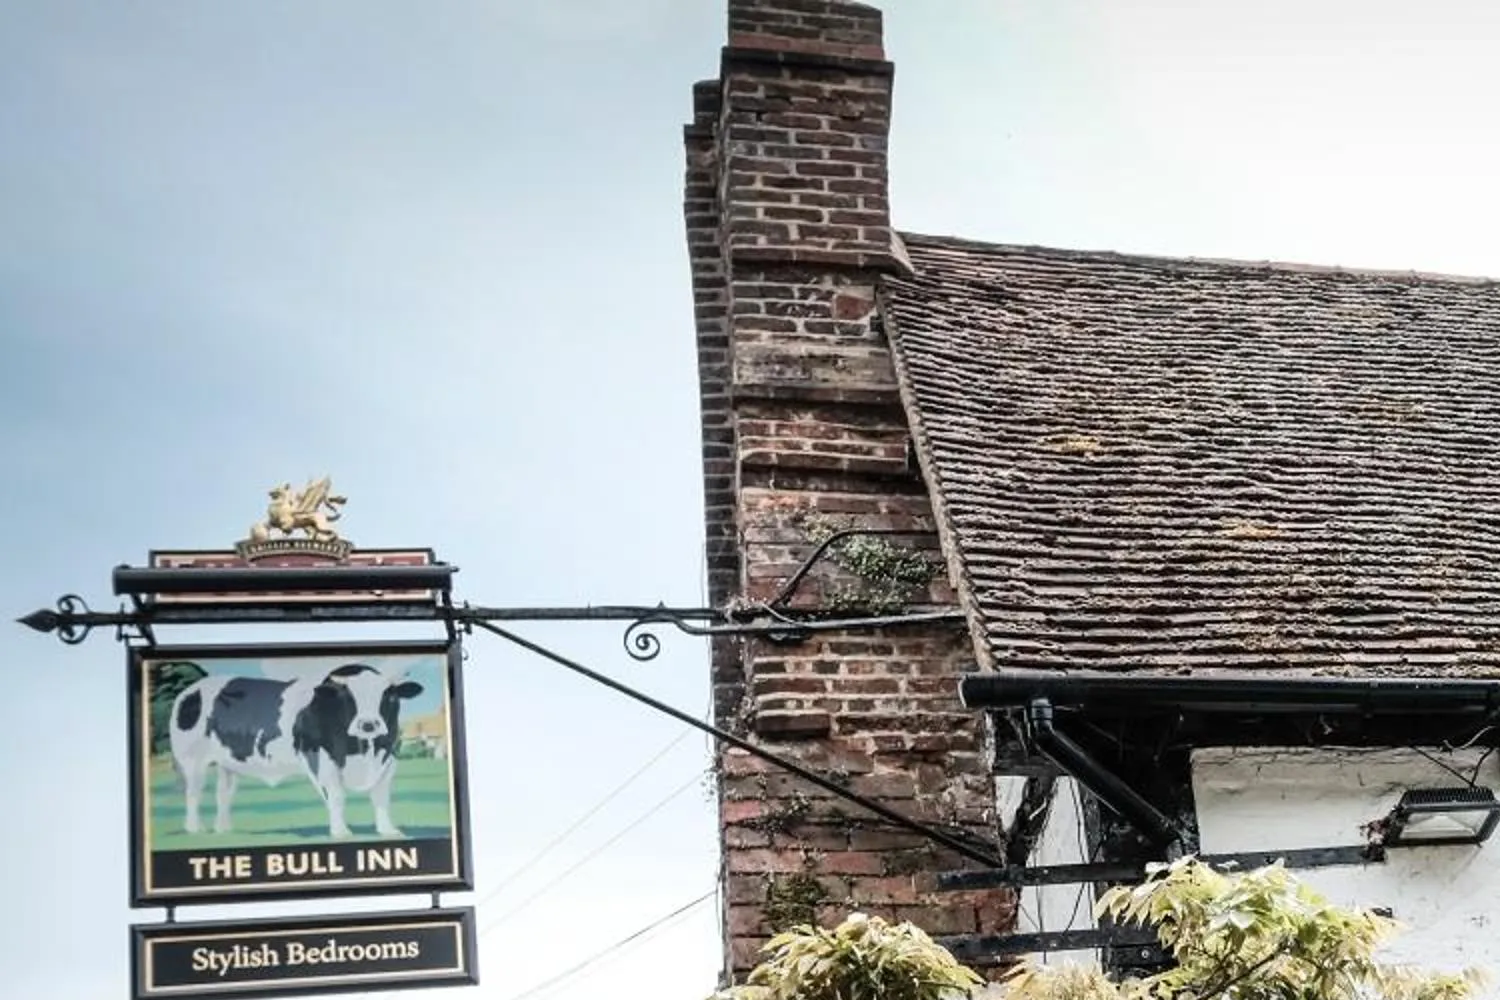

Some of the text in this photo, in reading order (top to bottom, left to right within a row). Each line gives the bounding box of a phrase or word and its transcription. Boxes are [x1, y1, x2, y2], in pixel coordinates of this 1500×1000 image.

[188, 847, 419, 880] THE BULL INN
[191, 938, 420, 976] Stylish Bedrooms
